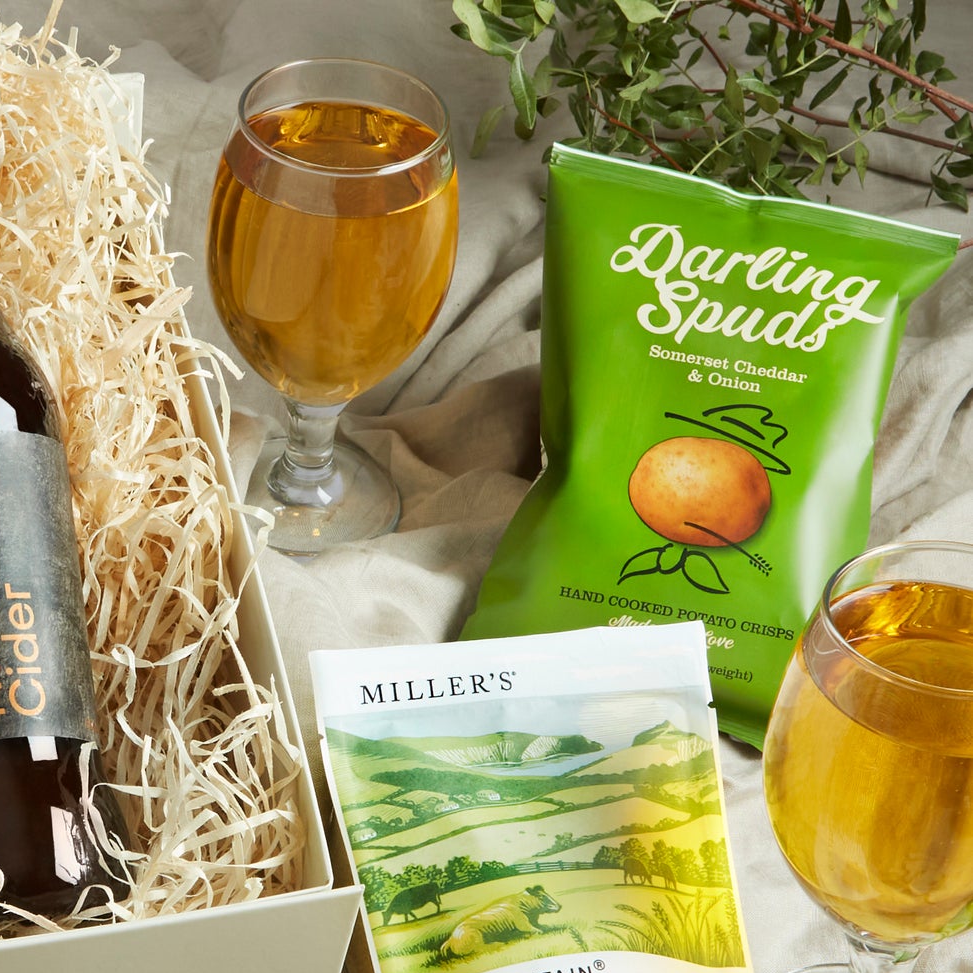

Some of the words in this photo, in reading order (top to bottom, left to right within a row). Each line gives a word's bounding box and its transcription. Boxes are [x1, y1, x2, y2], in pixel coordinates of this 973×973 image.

[610, 223, 885, 325] Darling
[636, 280, 835, 352] Spuds
[649, 344, 729, 370] Somerset
[733, 358, 808, 384] Cheddar
[687, 369, 703, 383] &
[708, 373, 761, 393] Onion
[559, 586, 605, 604] HAND
[608, 595, 673, 616] COOKED
[677, 608, 737, 630] POTATO
[740, 620, 795, 641] CRISPS
[608, 614, 657, 627] Mad
[1, 583, 47, 717] Cider
